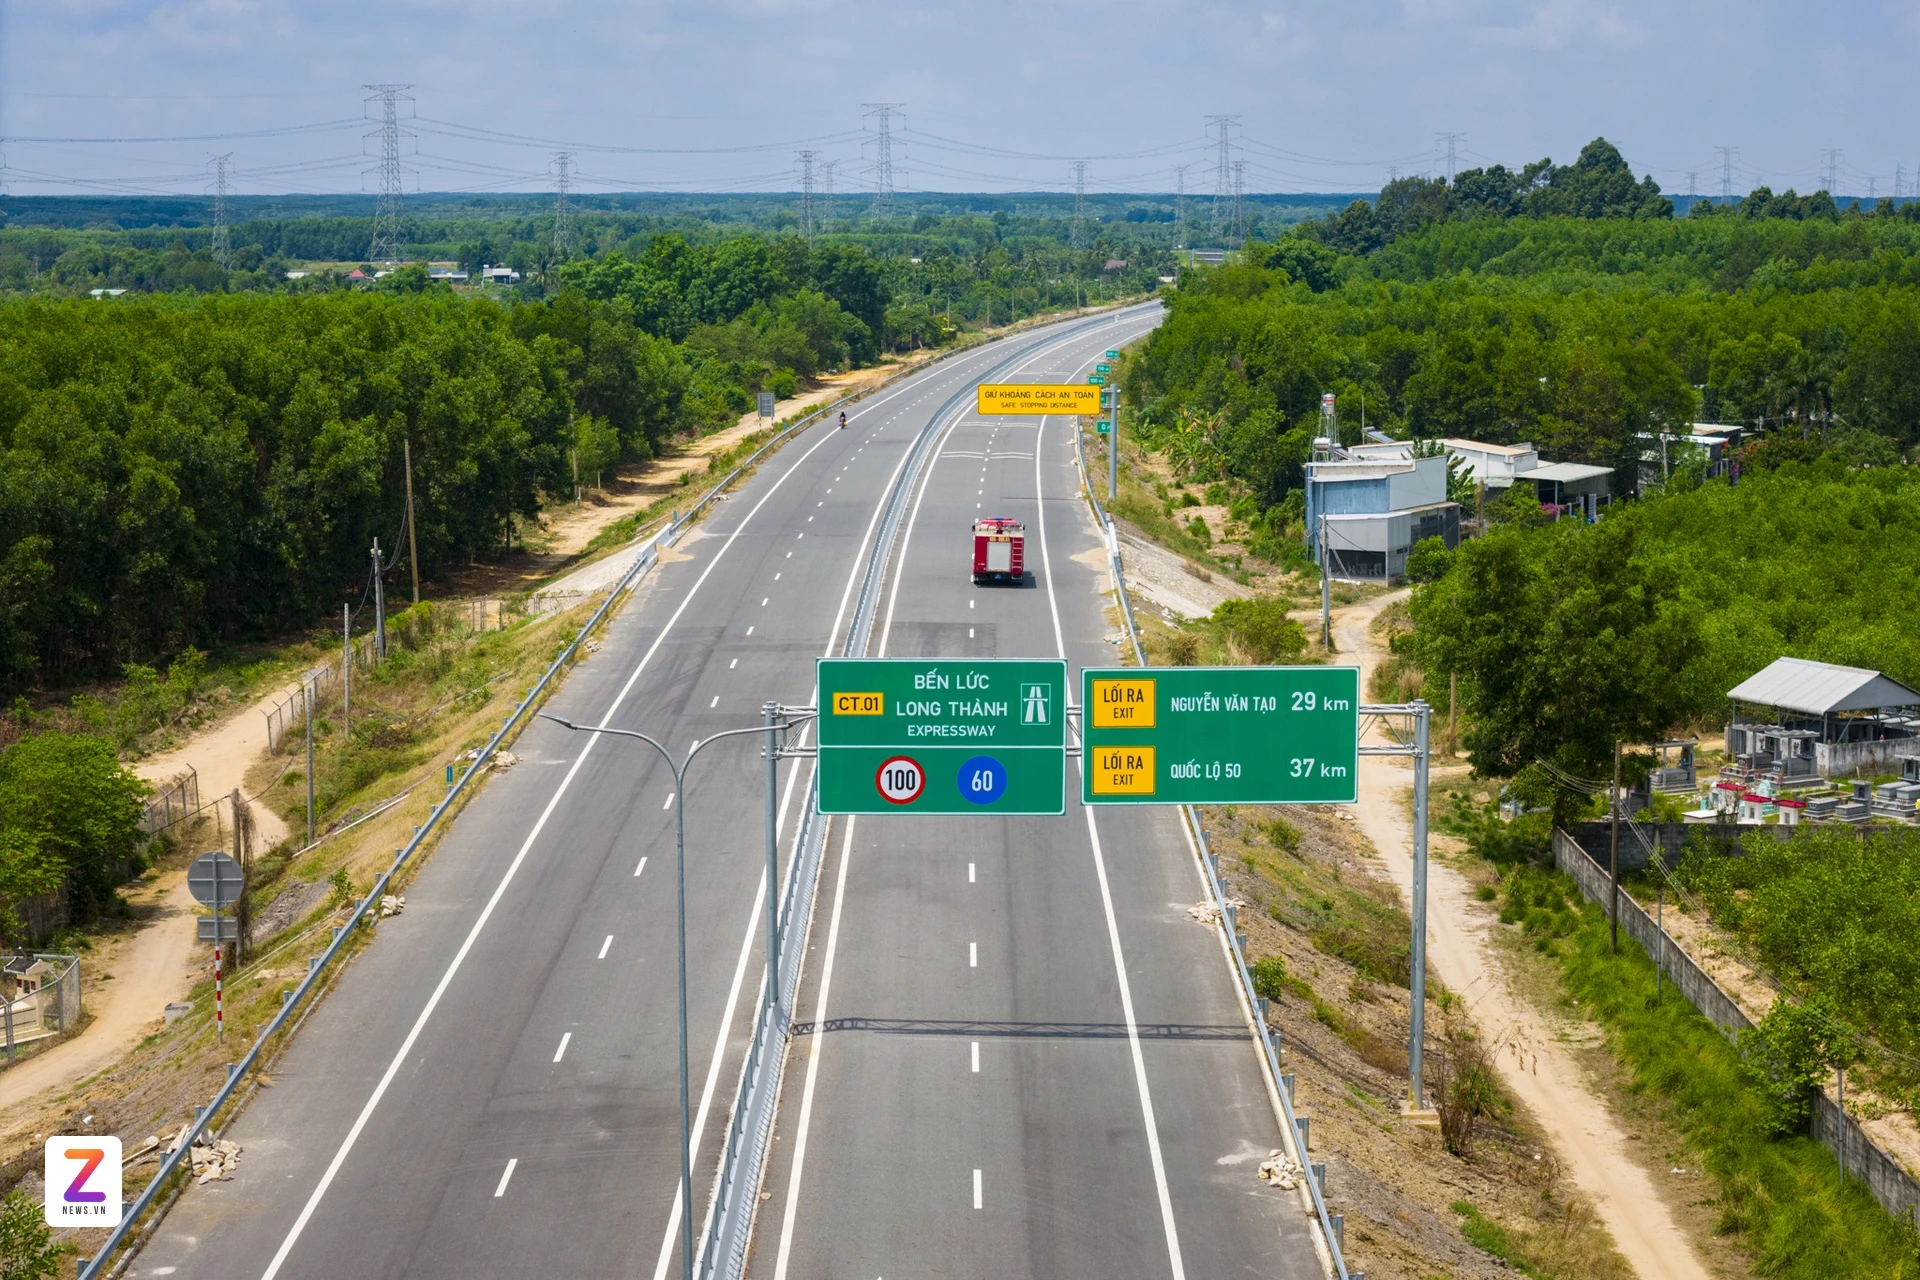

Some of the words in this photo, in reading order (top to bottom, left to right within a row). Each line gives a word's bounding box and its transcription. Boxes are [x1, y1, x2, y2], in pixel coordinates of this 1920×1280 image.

[914, 668, 949, 689] BẾN
[956, 670, 989, 689] LỨC
[1104, 684, 1122, 703] LỐI
[1127, 688, 1144, 703] RA
[1171, 692, 1220, 712] NGUYỄN
[1224, 694, 1248, 711] VĂN
[1253, 696, 1276, 714] TẠO
[1291, 691, 1316, 711] 29
[1323, 696, 1349, 711] km
[838, 696, 879, 711] CT.01
[896, 702, 941, 716] LONG
[948, 698, 1008, 716] THÀNH
[1113, 707, 1134, 719] EXIT
[907, 725, 996, 737] EXPRESSWAY
[1104, 751, 1122, 770] LỐI
[1127, 756, 1144, 770] RA
[1170, 759, 1201, 779] QUỐC
[1205, 761, 1220, 781] LỘ
[1225, 764, 1241, 778] 50
[1289, 758, 1316, 778] 37
[1321, 762, 1346, 777] km
[885, 769, 916, 791] 100
[971, 770, 993, 792] 60
[1113, 774, 1134, 785] EXIT
